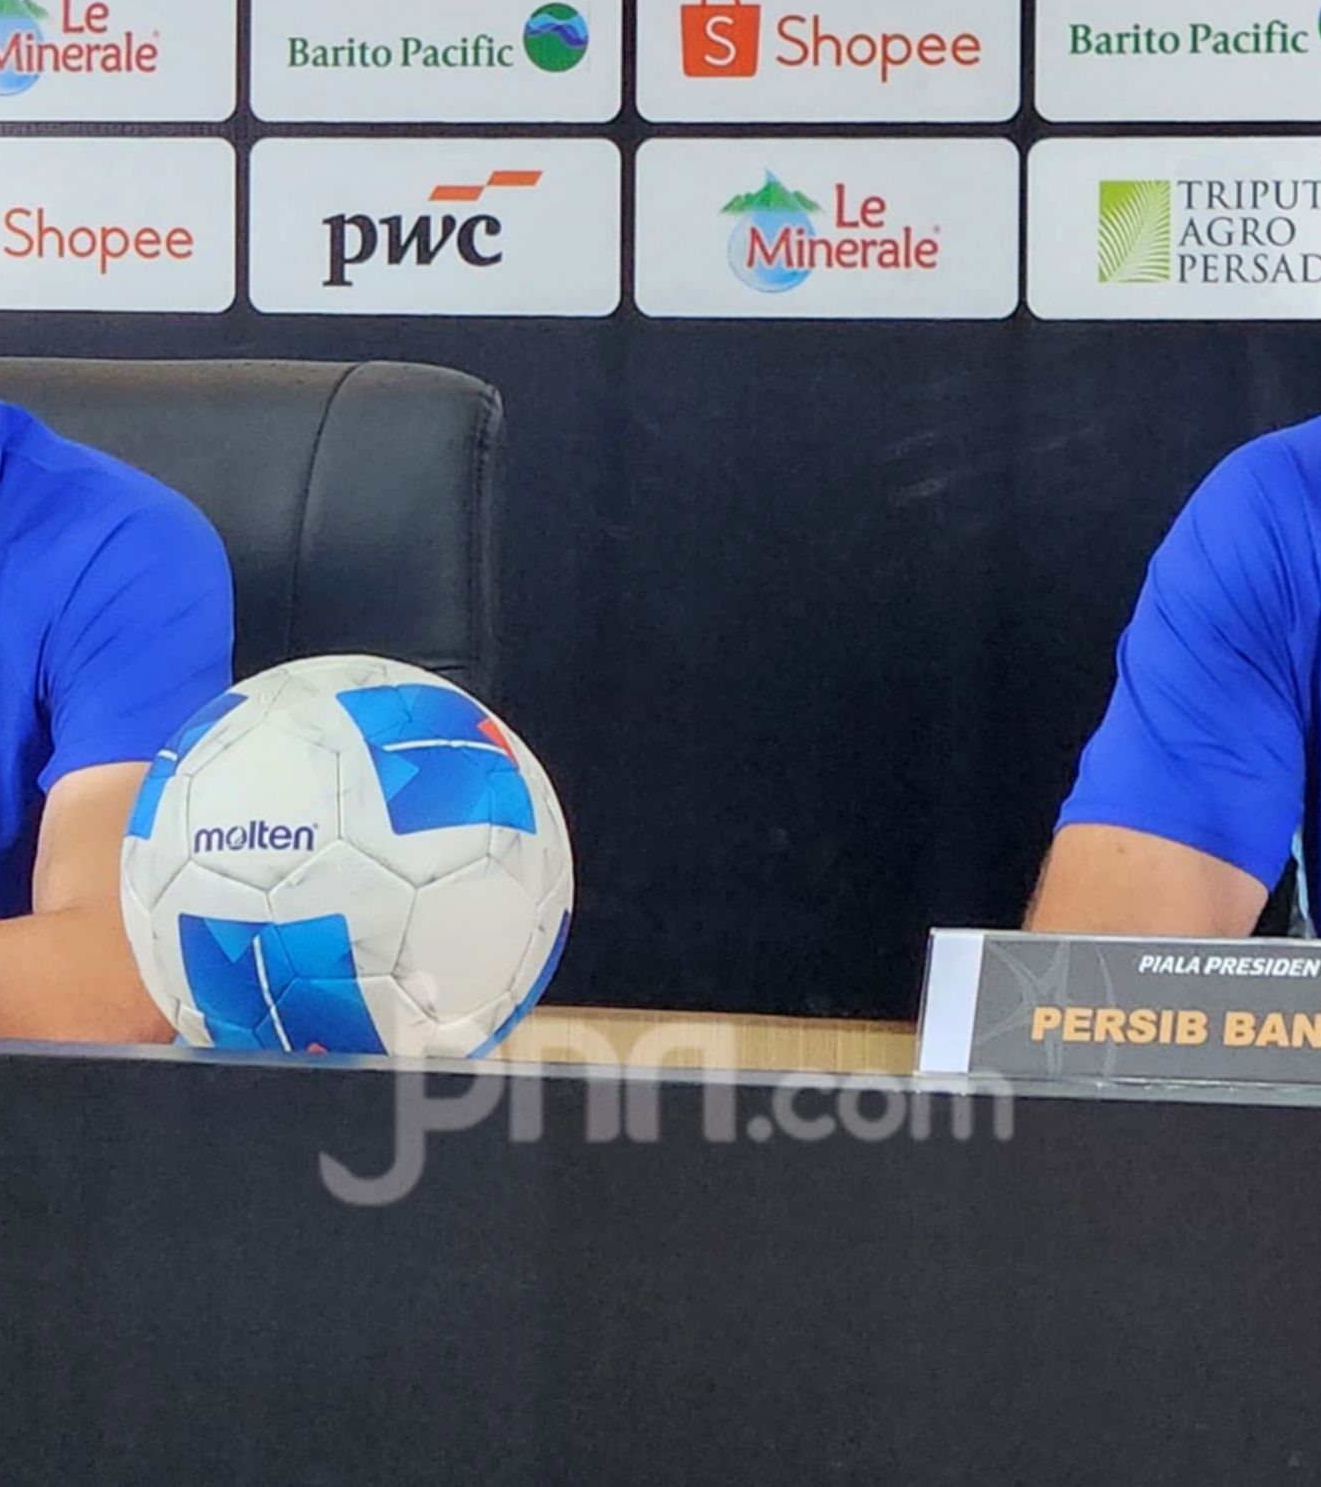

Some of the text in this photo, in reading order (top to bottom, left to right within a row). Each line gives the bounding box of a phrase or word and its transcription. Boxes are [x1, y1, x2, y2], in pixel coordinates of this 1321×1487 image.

[287, 37, 514, 69] Barito Pacific
[776, 15, 982, 83] Shopee
[1070, 21, 1309, 56] Barito Pacific
[835, 183, 886, 229] Le
[3, 208, 194, 274] Shopee
[322, 211, 502, 286] pwc
[747, 226, 939, 271] Minerale
[1178, 215, 1297, 247] AGRO
[193, 820, 315, 854] molten
[1138, 954, 1201, 975] PIALA
[1204, 955, 1320, 977] PRESIDEN
[1031, 1007, 1209, 1047] PERSIB
